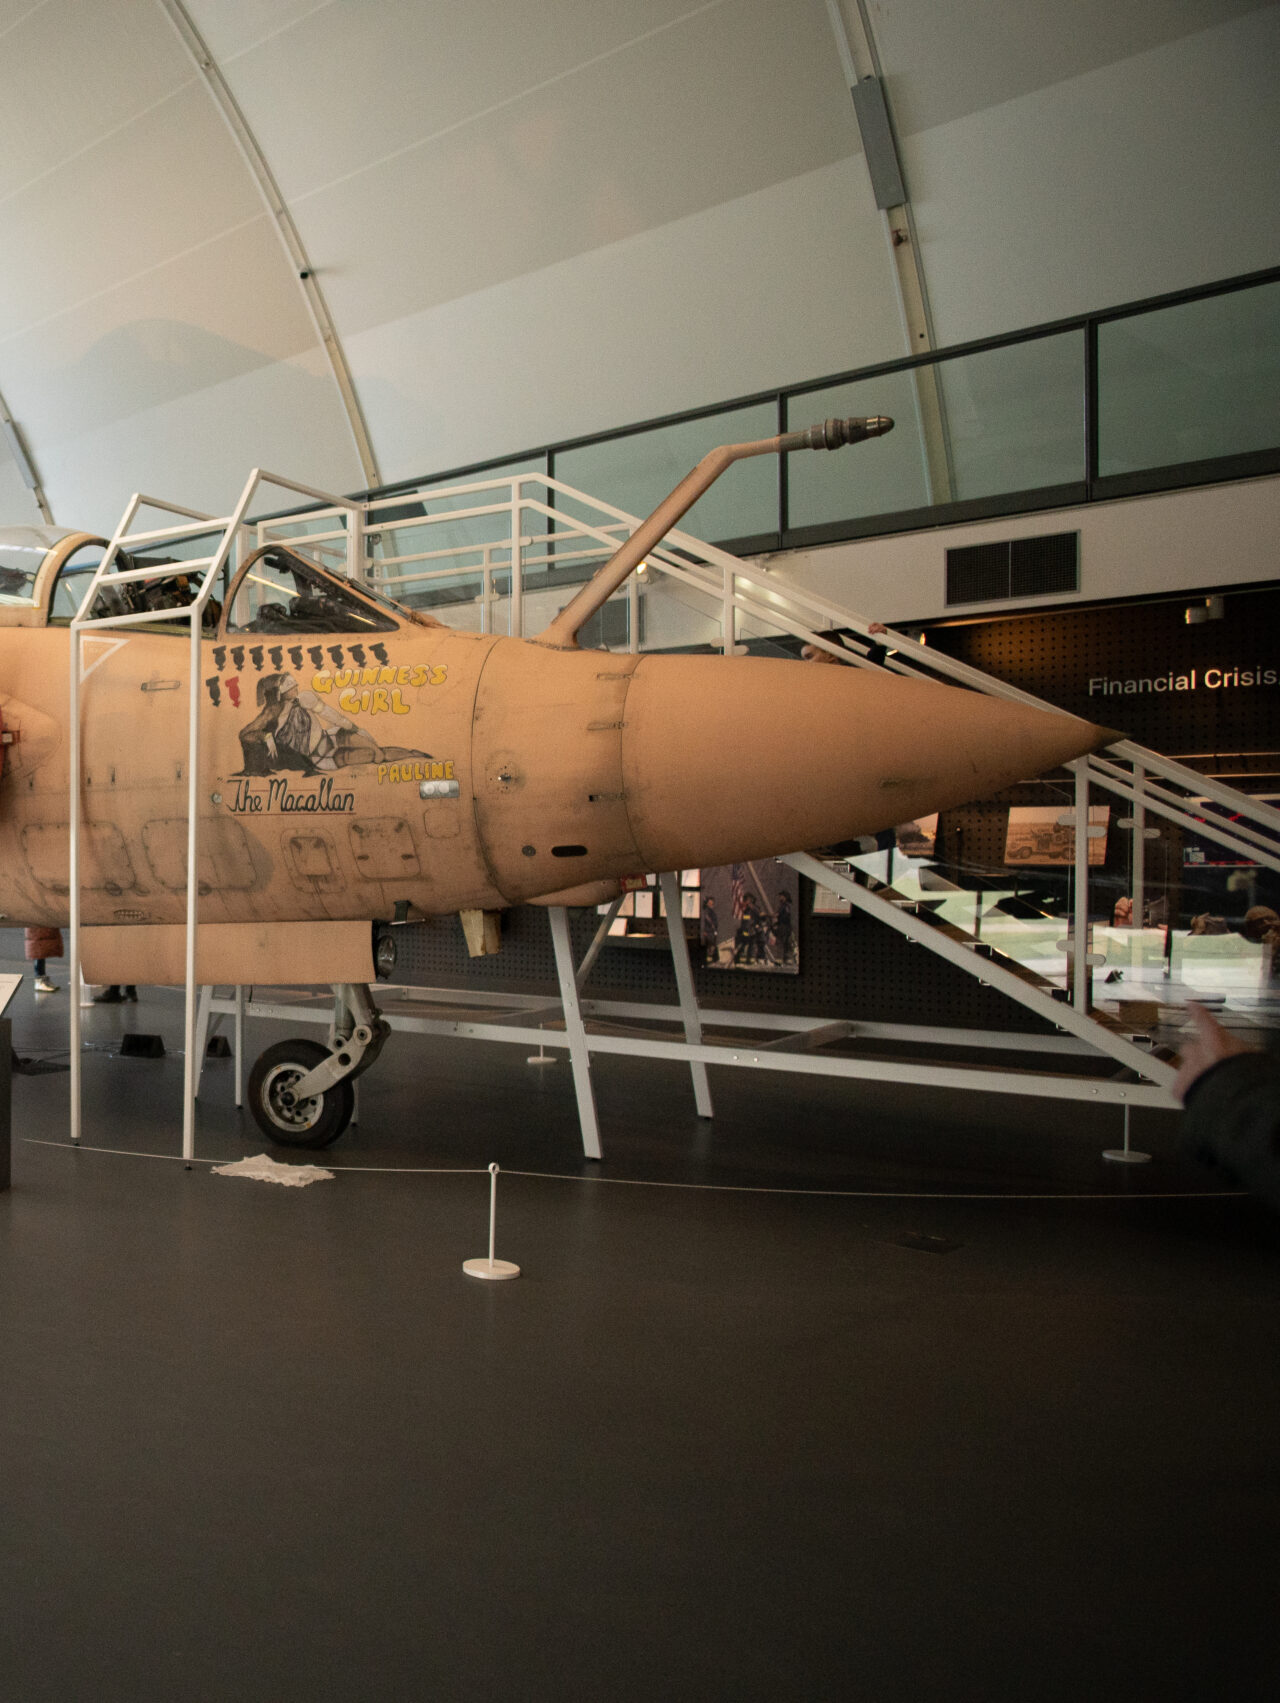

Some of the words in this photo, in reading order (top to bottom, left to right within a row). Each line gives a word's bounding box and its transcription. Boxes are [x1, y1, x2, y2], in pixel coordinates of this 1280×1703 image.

[311, 664, 448, 693] GUINNESS
[1088, 669, 1196, 696] Financial
[1204, 665, 1280, 689] Crisis
[339, 688, 411, 715] GIRL
[377, 760, 455, 784] PAULINE
